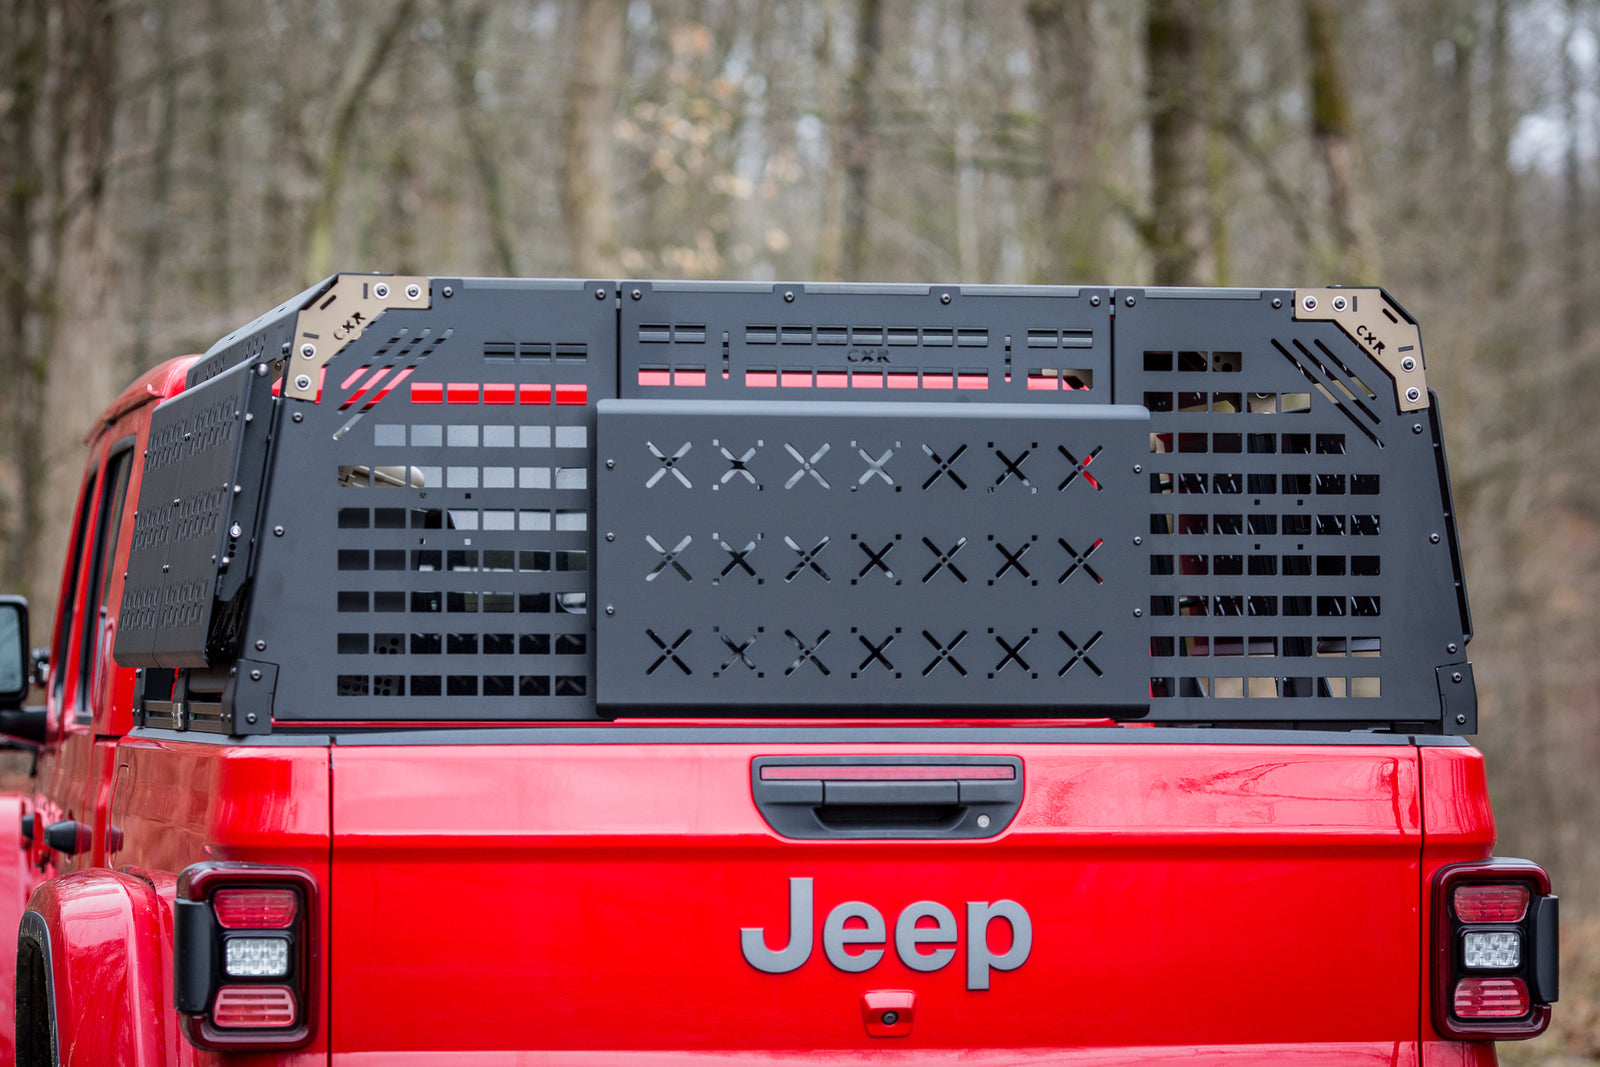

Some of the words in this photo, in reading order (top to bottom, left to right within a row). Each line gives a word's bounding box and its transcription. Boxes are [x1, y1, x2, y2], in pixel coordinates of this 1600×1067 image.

[333, 312, 366, 340] CXR
[1356, 325, 1385, 355] CXR
[847, 349, 891, 363] CXR
[740, 876, 1033, 991] Jeep
